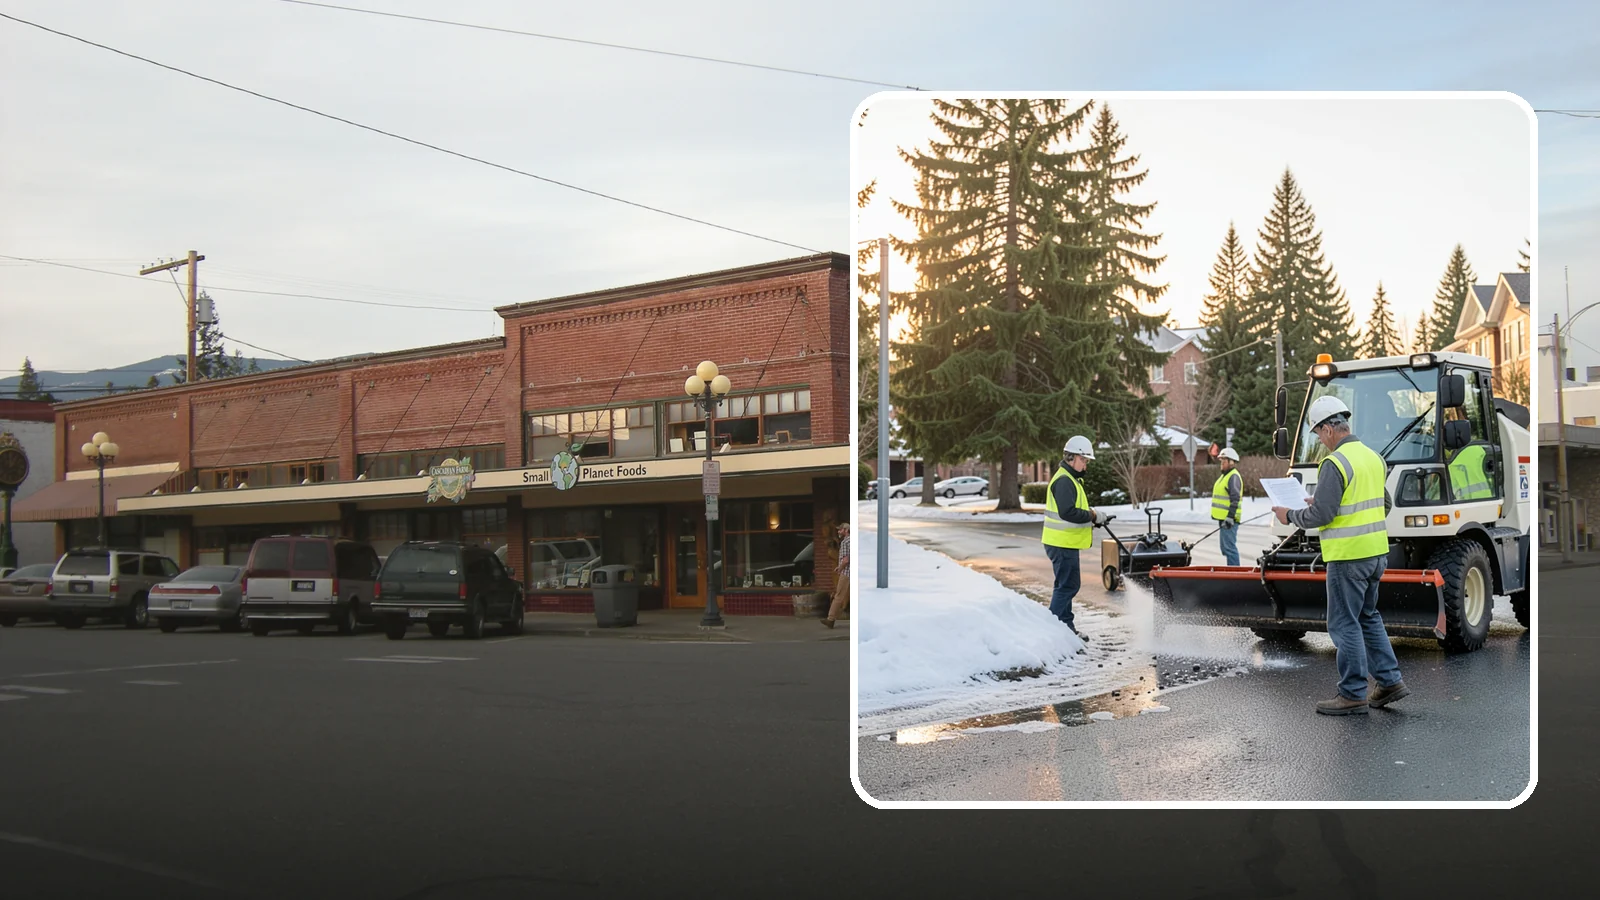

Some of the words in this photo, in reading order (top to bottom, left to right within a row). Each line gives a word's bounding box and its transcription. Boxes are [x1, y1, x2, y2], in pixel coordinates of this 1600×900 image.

[523, 470, 549, 483] Small
[583, 467, 614, 479] Planet
[617, 464, 647, 477] Foods
